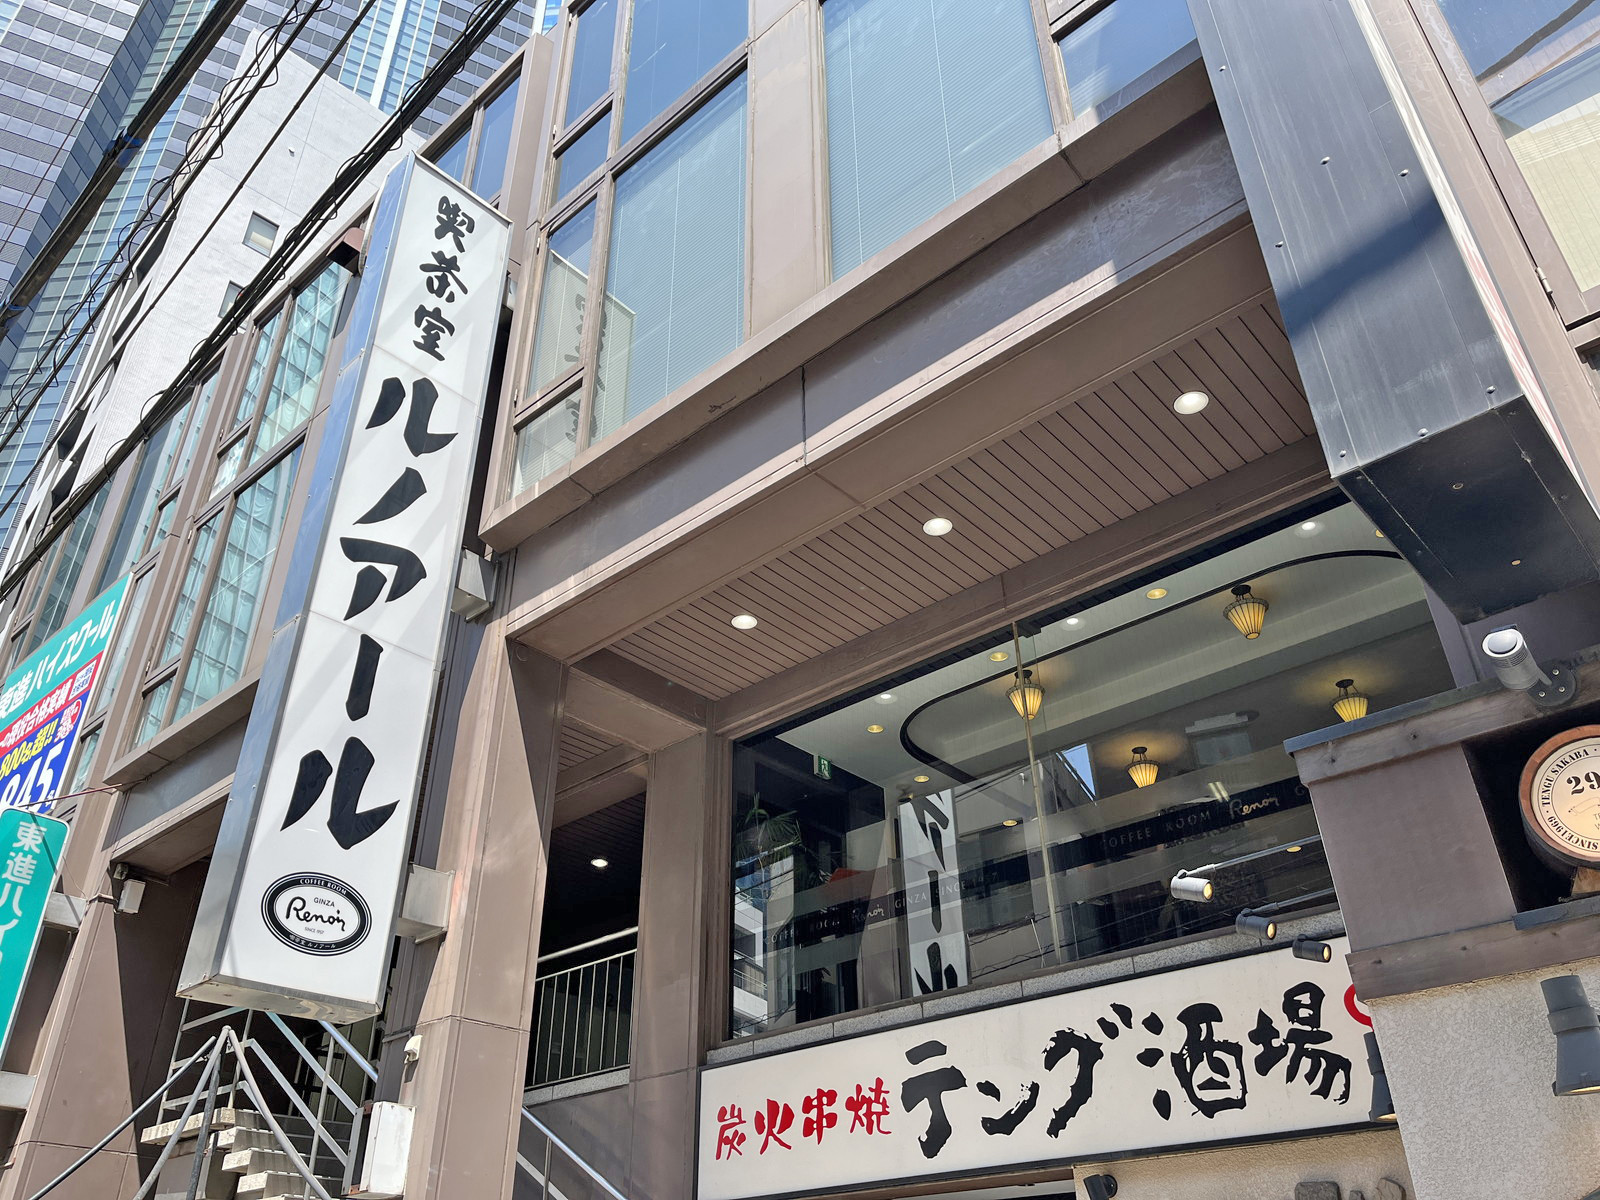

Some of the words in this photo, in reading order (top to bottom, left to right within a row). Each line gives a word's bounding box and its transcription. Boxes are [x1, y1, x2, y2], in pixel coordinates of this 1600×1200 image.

[412, 195, 476, 362] 喫茶室
[280, 377, 459, 850] ルノアール
[0, 599, 115, 719] 東進ハイスクール
[0, 678, 73, 748] の現役合格実績
[1541, 775, 1554, 807] TENGU
[1551, 748, 1590, 775] SAKABA
[0, 820, 47, 965] 東進ハイ
[285, 896, 346, 932] Renoir
[300, 878, 325, 887] COFFEE
[327, 880, 347, 895] ROOM
[313, 897, 335, 908] GINZA
[894, 891, 927, 909] GINZA
[714, 1077, 892, 1161] 炭火串焼
[900, 980, 1352, 1159] テング酒場
